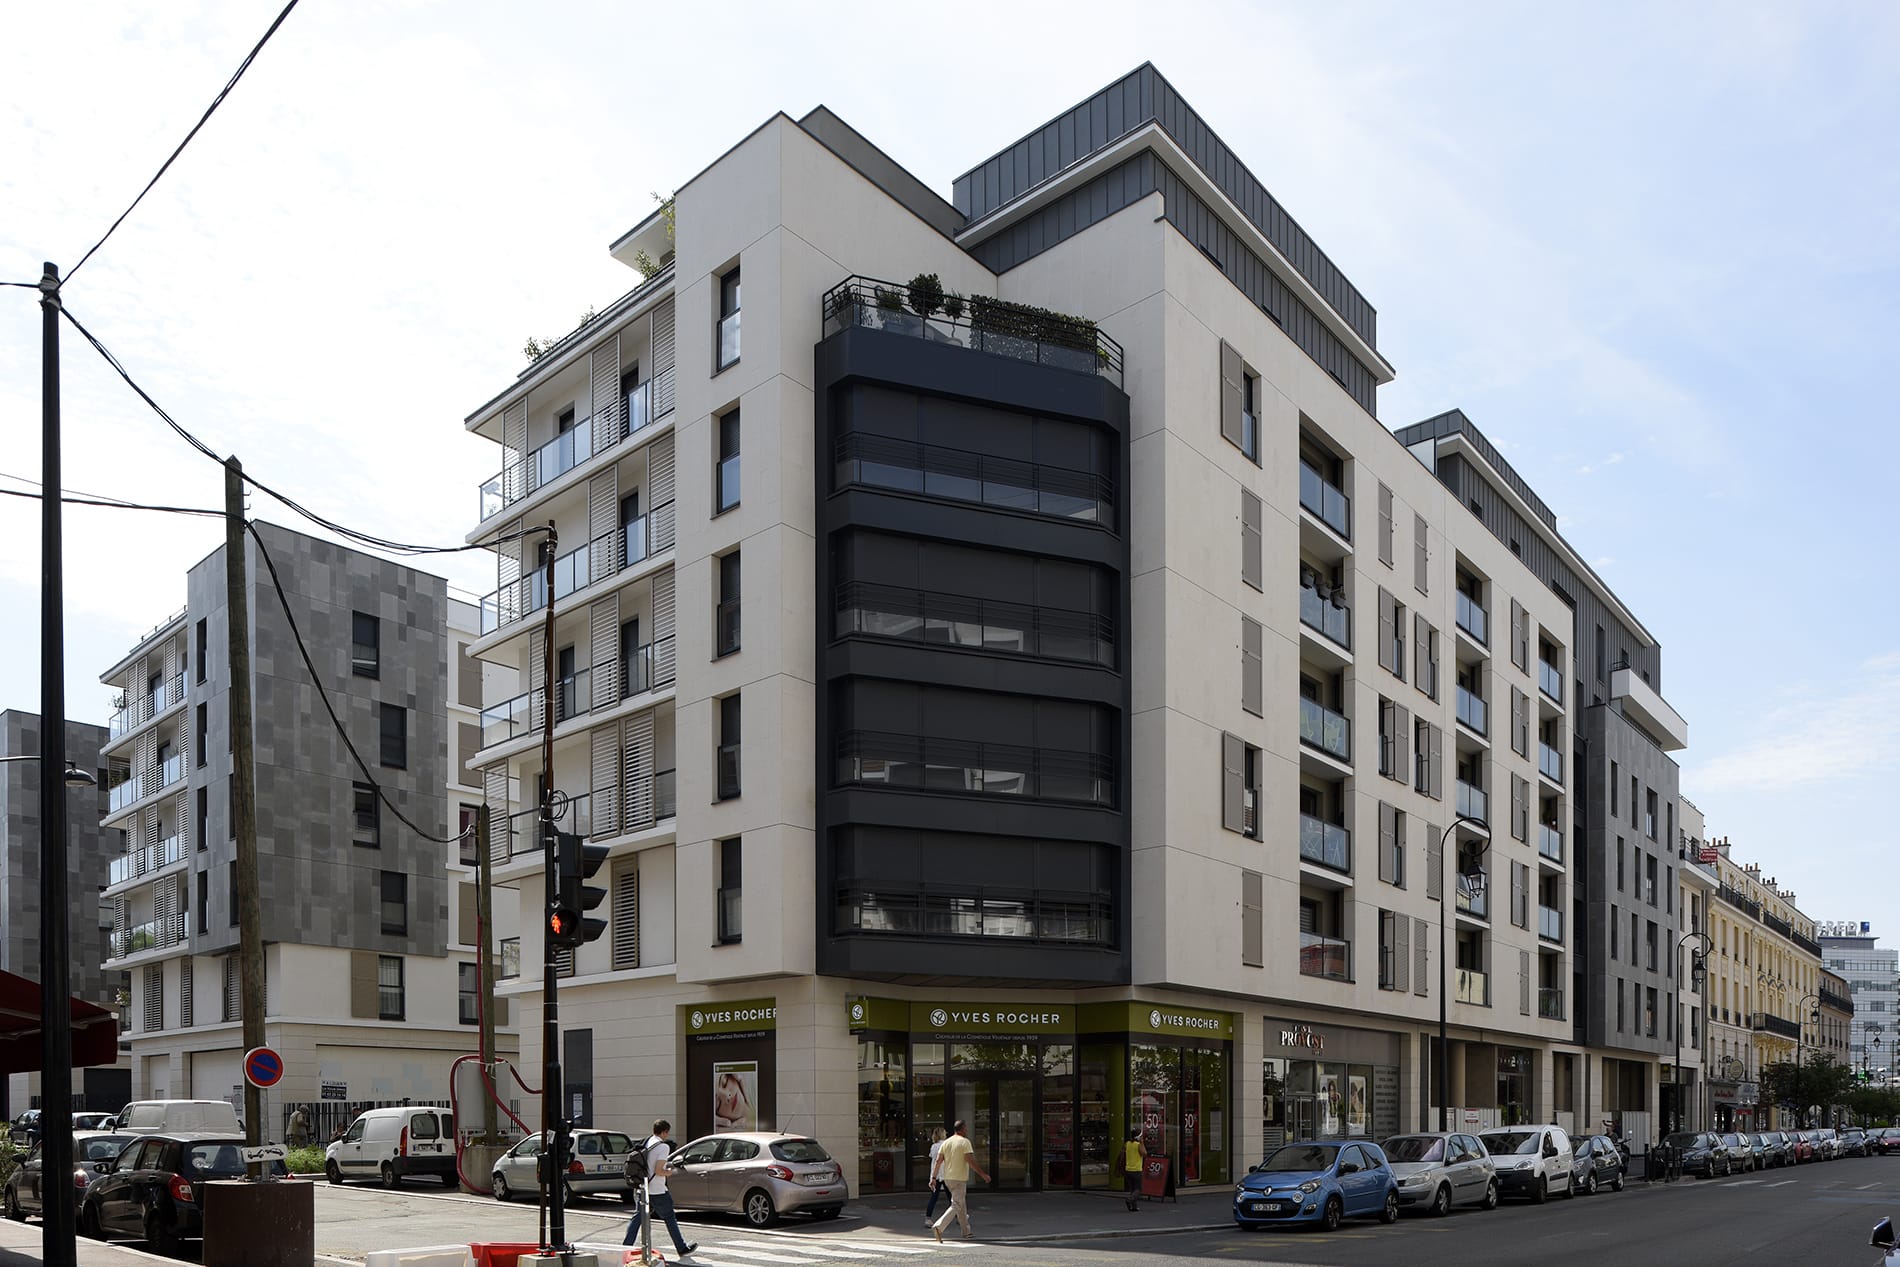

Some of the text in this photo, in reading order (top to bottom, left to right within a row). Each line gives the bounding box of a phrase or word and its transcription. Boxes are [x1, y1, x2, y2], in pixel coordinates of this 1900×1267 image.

[704, 1011, 731, 1023] YVES
[951, 1012, 1061, 1024] YVES ROCHER
[1161, 1014, 1219, 1030] YVES ROCHER
[1281, 1030, 1326, 1049] PROVOST
